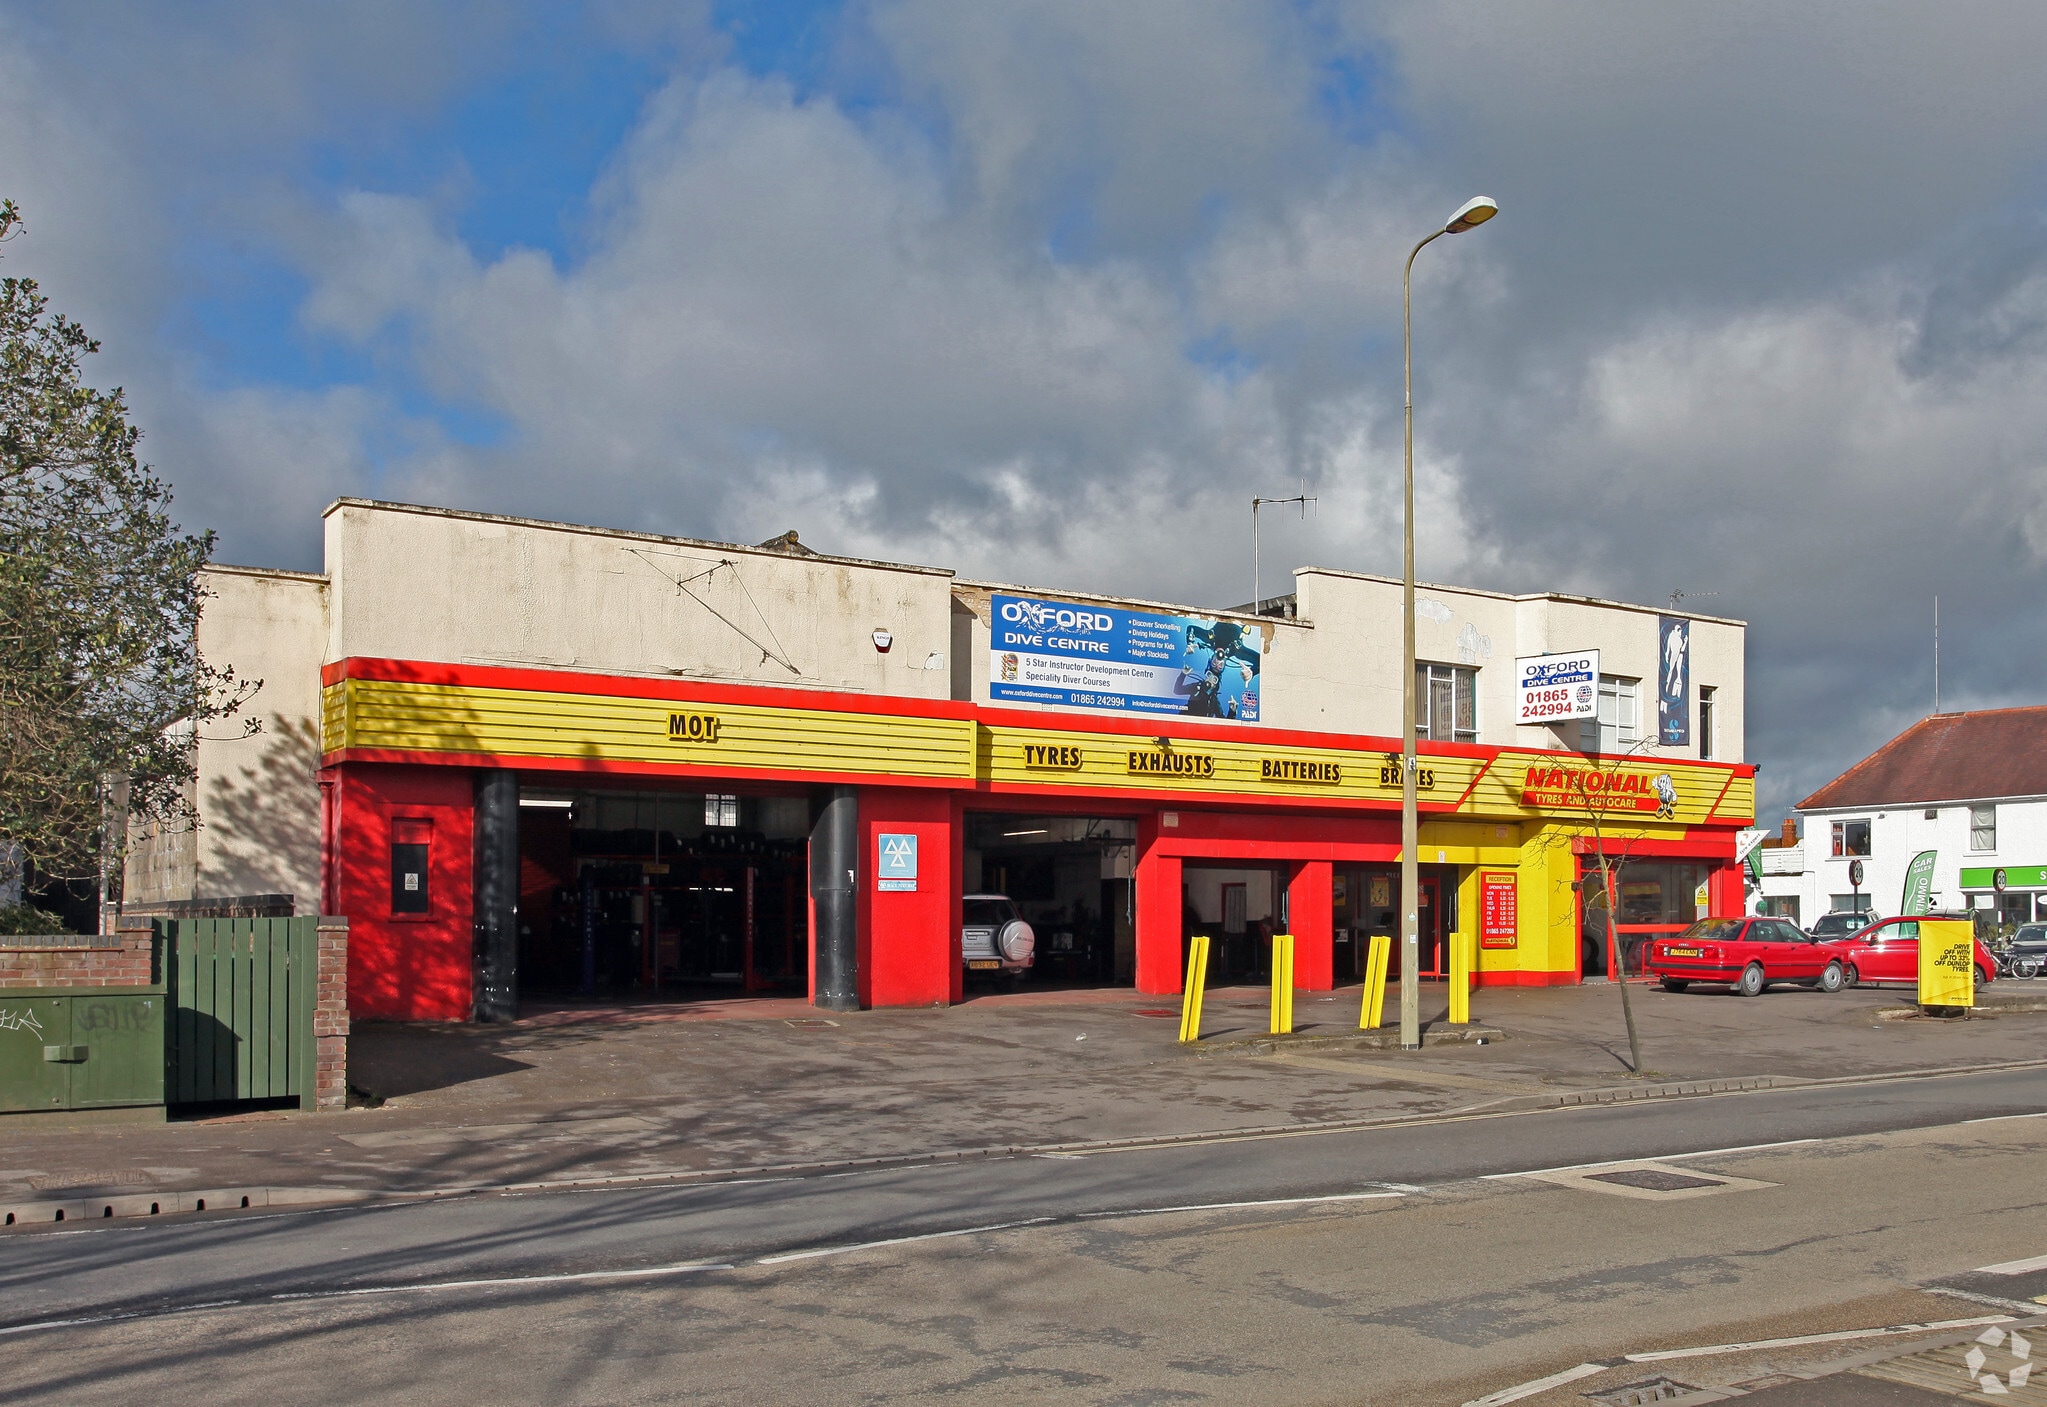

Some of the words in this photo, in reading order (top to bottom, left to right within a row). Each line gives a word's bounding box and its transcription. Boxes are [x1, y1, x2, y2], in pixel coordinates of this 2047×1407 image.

[1001, 601, 1113, 632] OXFORD
[1133, 620, 1153, 628] Discover
[1154, 622, 1181, 632] Snorkelling
[1133, 629, 1148, 638] Diving
[1149, 631, 1169, 640] Holidays
[1004, 632, 1043, 647] DIVE
[1047, 637, 1109, 653] CENTRE
[1132, 639, 1156, 649] Programs
[1164, 642, 1175, 650] Kids
[1132, 649, 1146, 659] Major
[1147, 651, 1169, 660] Stockists
[1026, 658, 1031, 666] 5
[1032, 658, 1048, 668] Star
[1049, 660, 1084, 671] Instructor
[1085, 664, 1130, 677] Development
[1131, 668, 1154, 679] Centre
[1526, 660, 1590, 675] OXFORD
[1026, 671, 1060, 685] Speciality
[1062, 674, 1081, 684] Diver
[1082, 676, 1111, 687] Courses
[1527, 678, 1549, 687] DIVE
[1551, 674, 1588, 684] CENTRE
[1000, 689, 1063, 700] www.oxforddivecentre.com
[1071, 693, 1095, 705] 01865
[1097, 695, 1125, 707] 242994
[1526, 688, 1568, 704] 01865
[1241, 710, 1257, 719] PADI
[1522, 702, 1572, 717] 242994
[1576, 704, 1592, 713] PADI
[669, 714, 715, 736] MOT
[1025, 746, 1079, 766] TYRES
[1129, 752, 1212, 774] EXHAUSTS
[1262, 759, 1340, 781] BATTERIES
[1381, 767, 1434, 786] BRAES
[1525, 767, 1650, 794] NATIONAL
[1536, 793, 1562, 804] TYRES
[1566, 796, 1586, 806] AND
[1589, 797, 1636, 808] AUTOCARE
[1913, 865, 1932, 874] SALES
[1914, 857, 1933, 868] CAR
[1856, 867, 1862, 878] 20
[1998, 875, 2005, 885] 20
[1916, 877, 1928, 912] TIMMO
